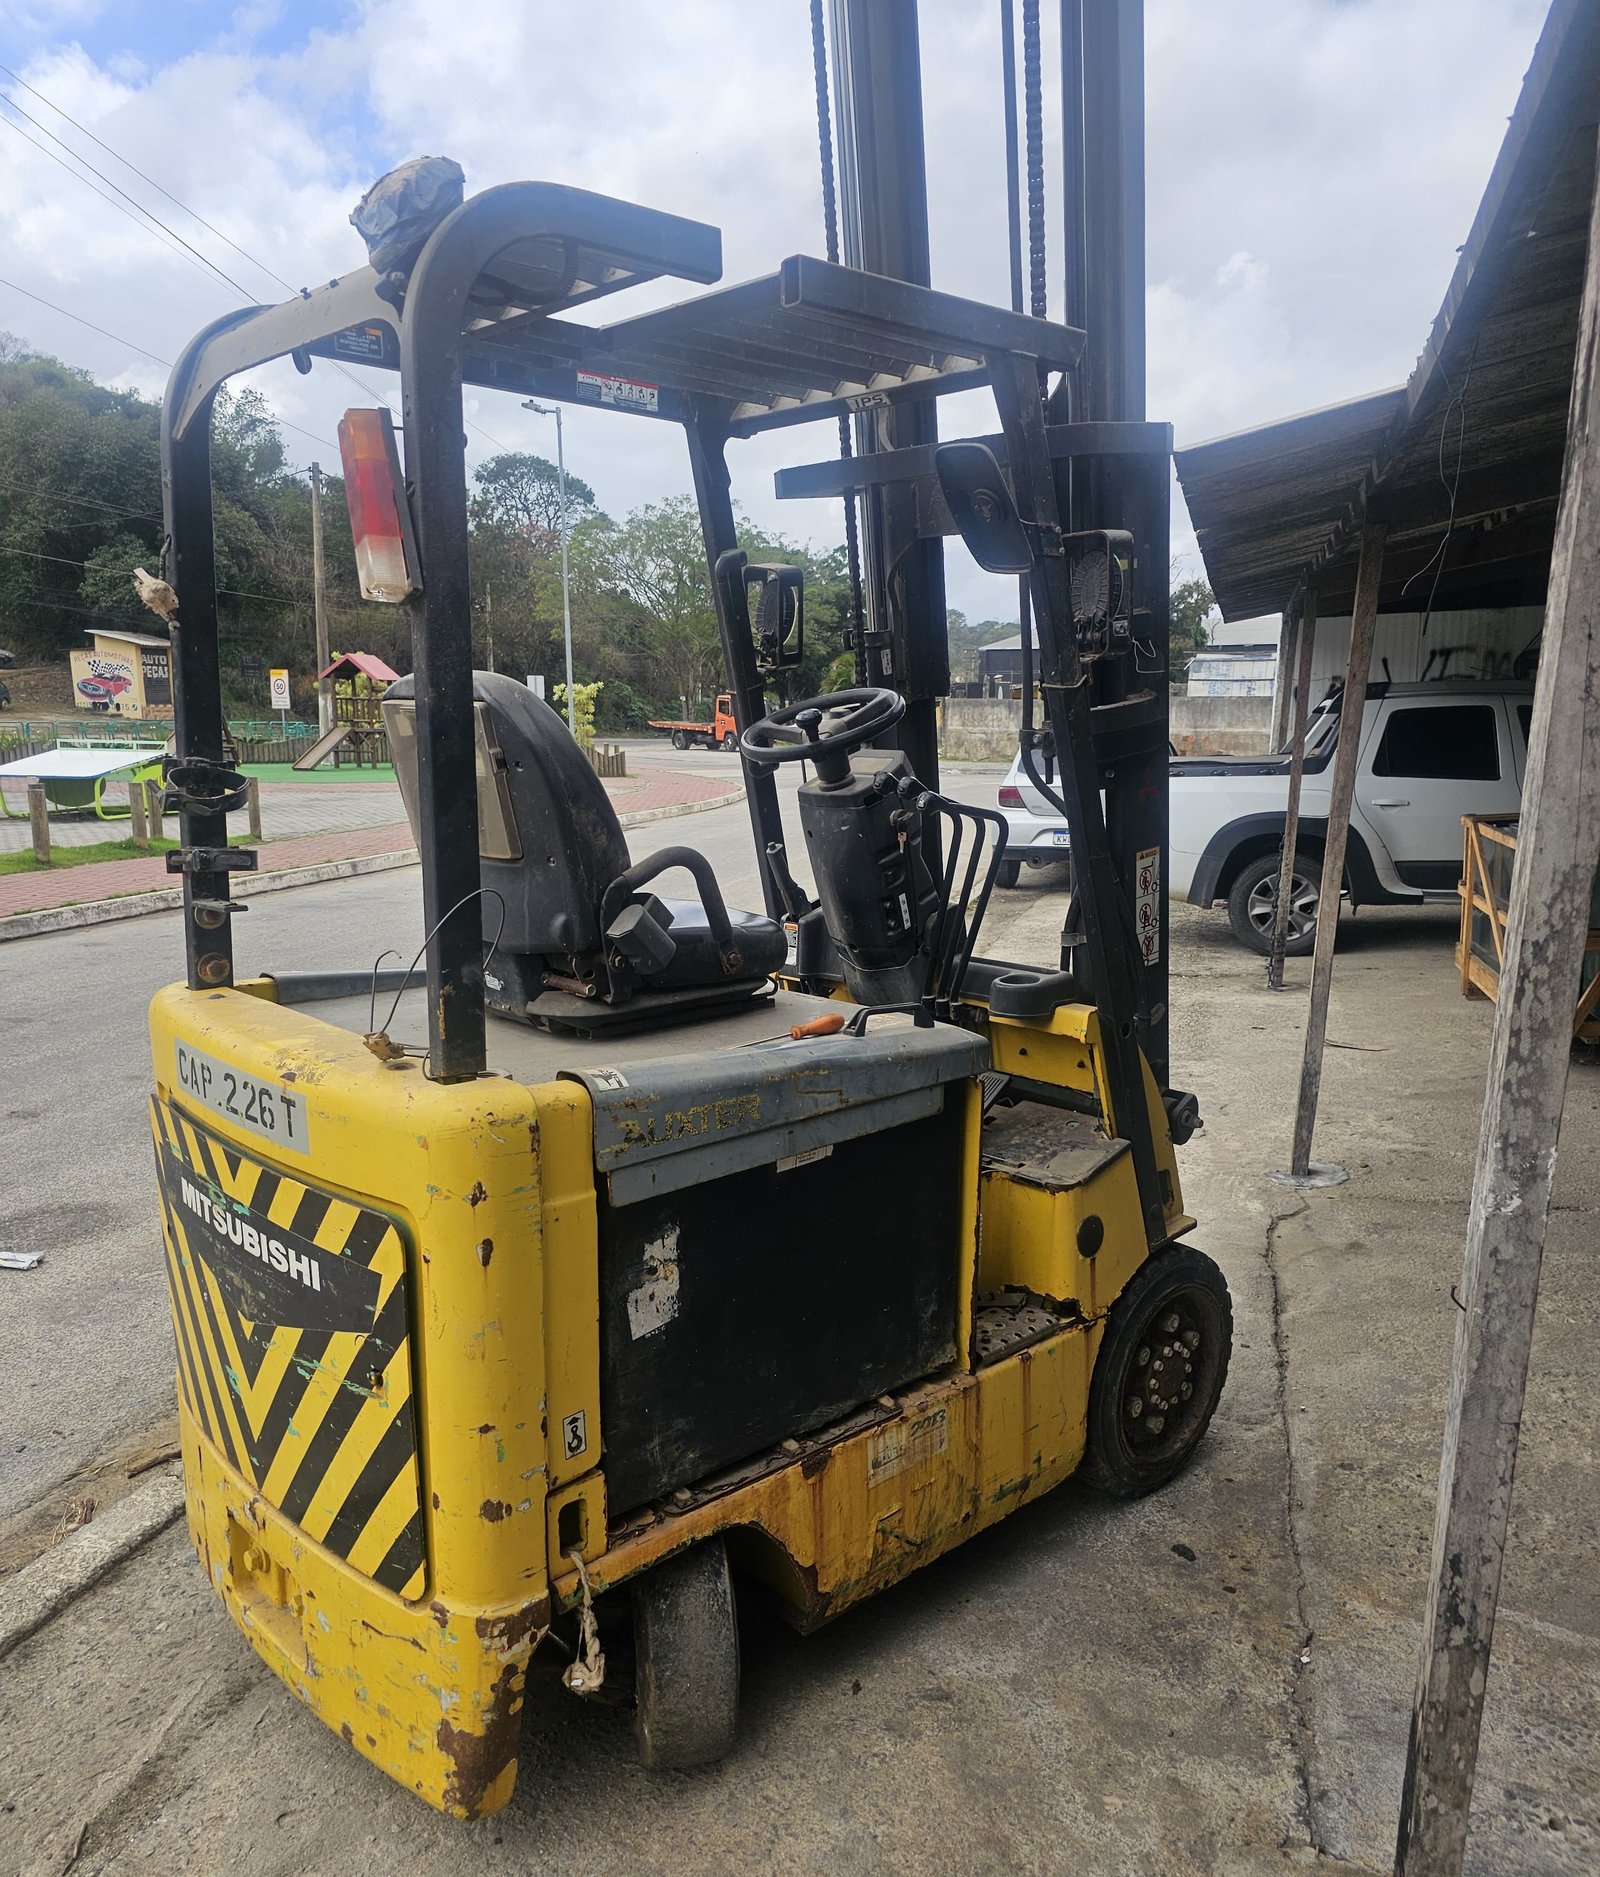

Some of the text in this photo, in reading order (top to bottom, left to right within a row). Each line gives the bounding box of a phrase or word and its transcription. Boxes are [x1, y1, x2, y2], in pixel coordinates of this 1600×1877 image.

[141, 654, 167, 665] AUTO
[142, 665, 168, 679] PEÇAS
[276, 682, 284, 690] 50
[180, 1176, 322, 1292] MITSUBISHI
